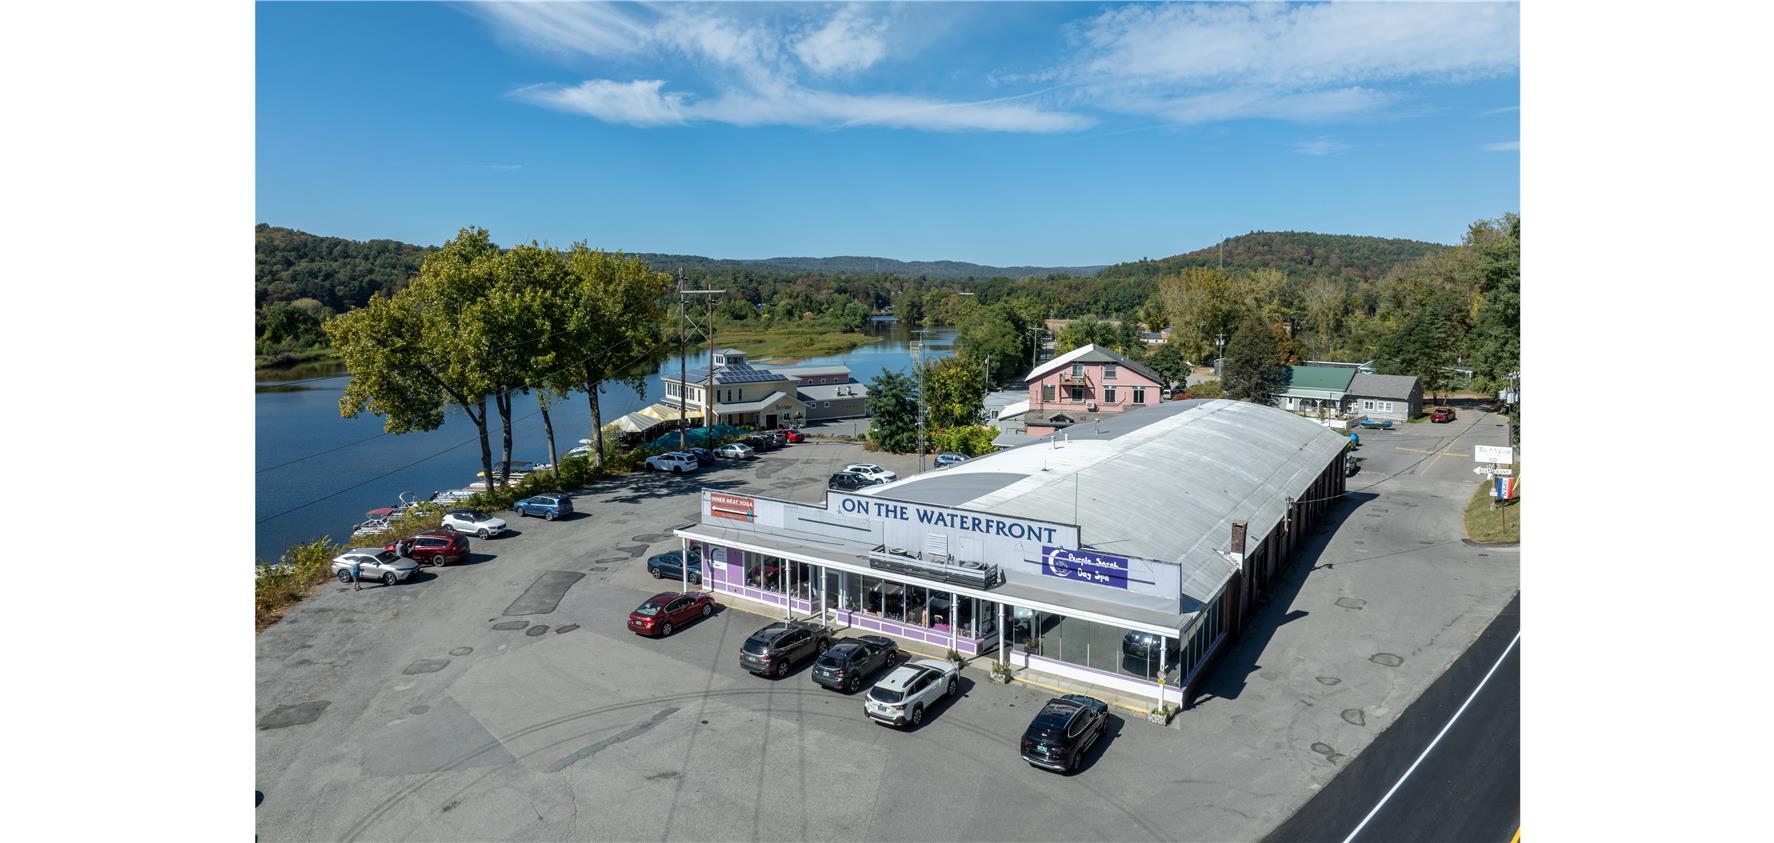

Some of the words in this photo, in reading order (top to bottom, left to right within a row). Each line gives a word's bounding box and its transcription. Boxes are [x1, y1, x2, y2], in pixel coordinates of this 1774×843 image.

[842, 498, 870, 515] ON
[874, 502, 909, 521] THE
[916, 508, 1056, 544] WATERFRONT
[1068, 553, 1092, 566] Purple
[1077, 567, 1092, 580] Day
[1094, 570, 1110, 582] Spa
